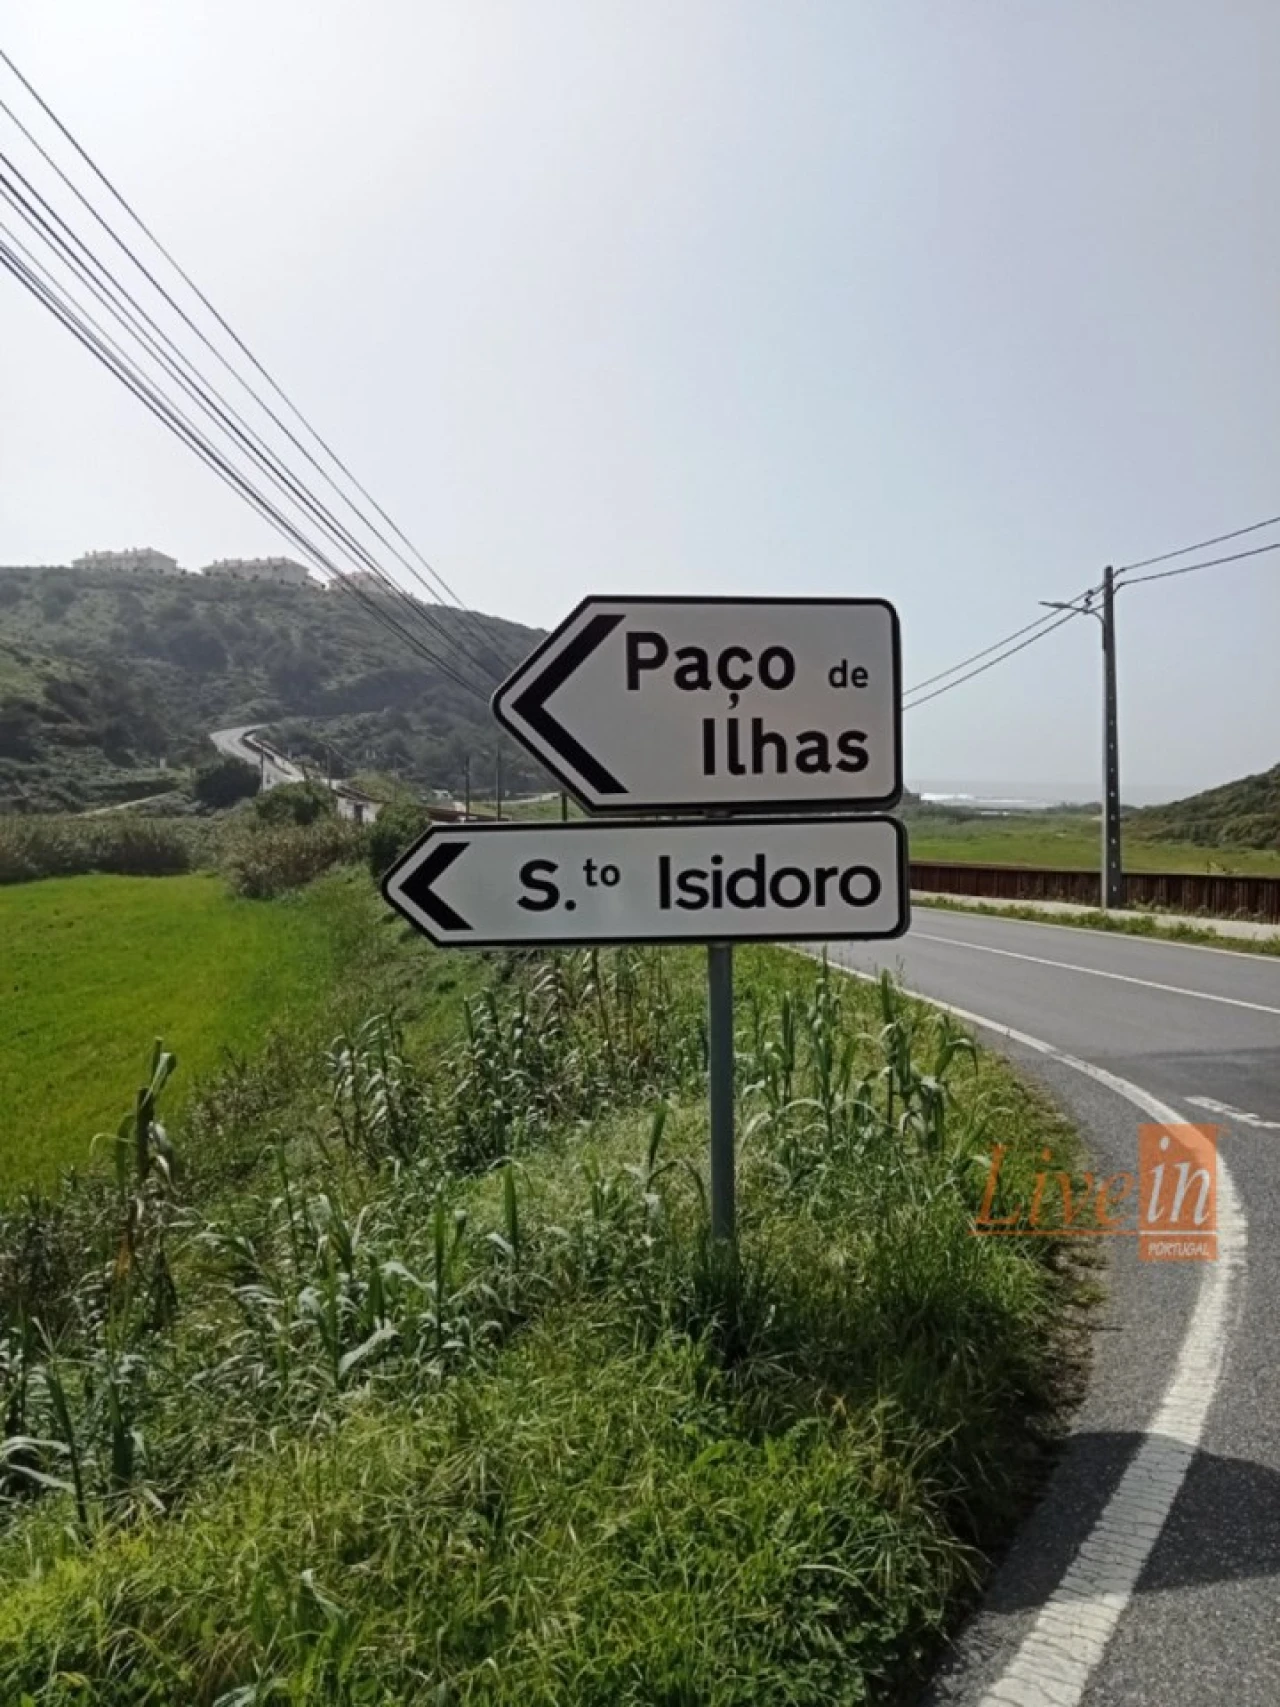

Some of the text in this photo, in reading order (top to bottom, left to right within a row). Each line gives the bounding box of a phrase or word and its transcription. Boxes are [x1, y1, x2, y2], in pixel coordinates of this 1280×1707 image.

[626, 631, 869, 709] Paço de
[702, 717, 870, 776] Ilhas
[658, 853, 882, 911] Isidoro
